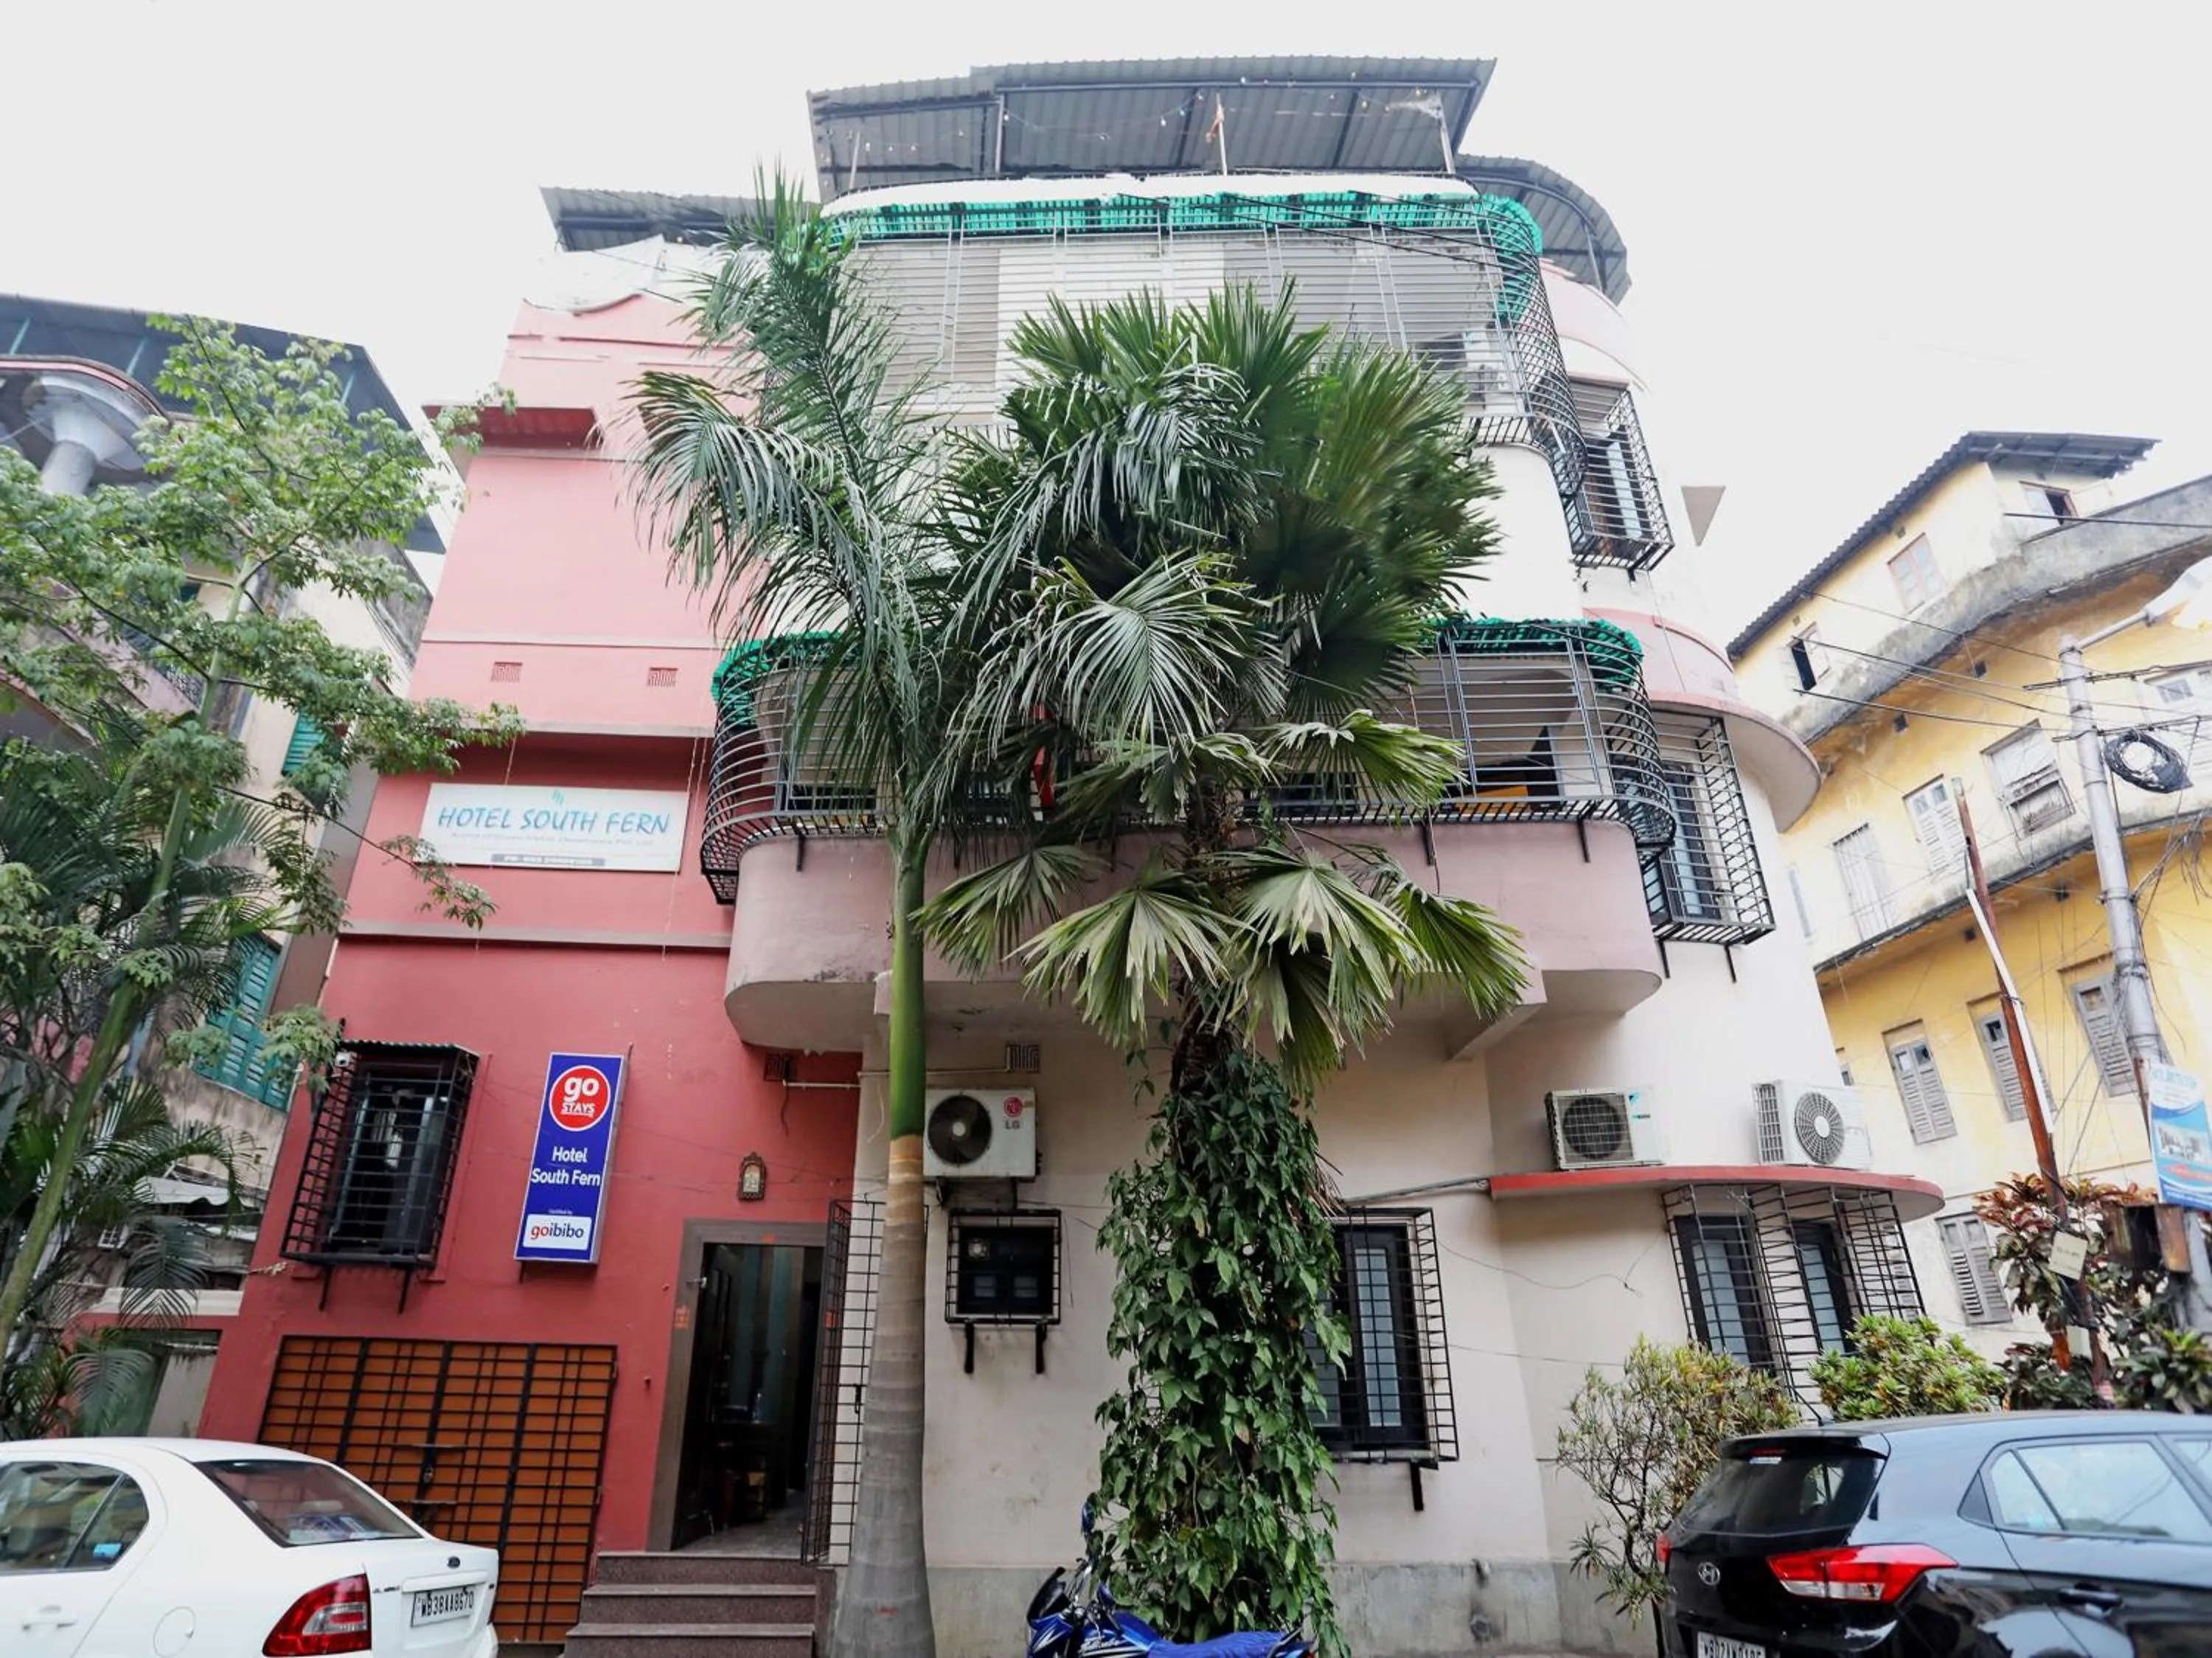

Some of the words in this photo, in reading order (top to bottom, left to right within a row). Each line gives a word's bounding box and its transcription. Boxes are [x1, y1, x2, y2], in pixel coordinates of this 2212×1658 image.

[438, 807, 512, 829] HOTEL
[520, 809, 597, 832] SOUTH
[605, 812, 670, 834] FERN
[564, 1077, 599, 1102] go
[561, 1102, 596, 1115] STAYS
[1005, 1120, 1020, 1129] LG
[552, 1145, 588, 1163] Hotel
[531, 1168, 570, 1185] South
[571, 1170, 601, 1187] Fern
[530, 1222, 584, 1240] goibibo
